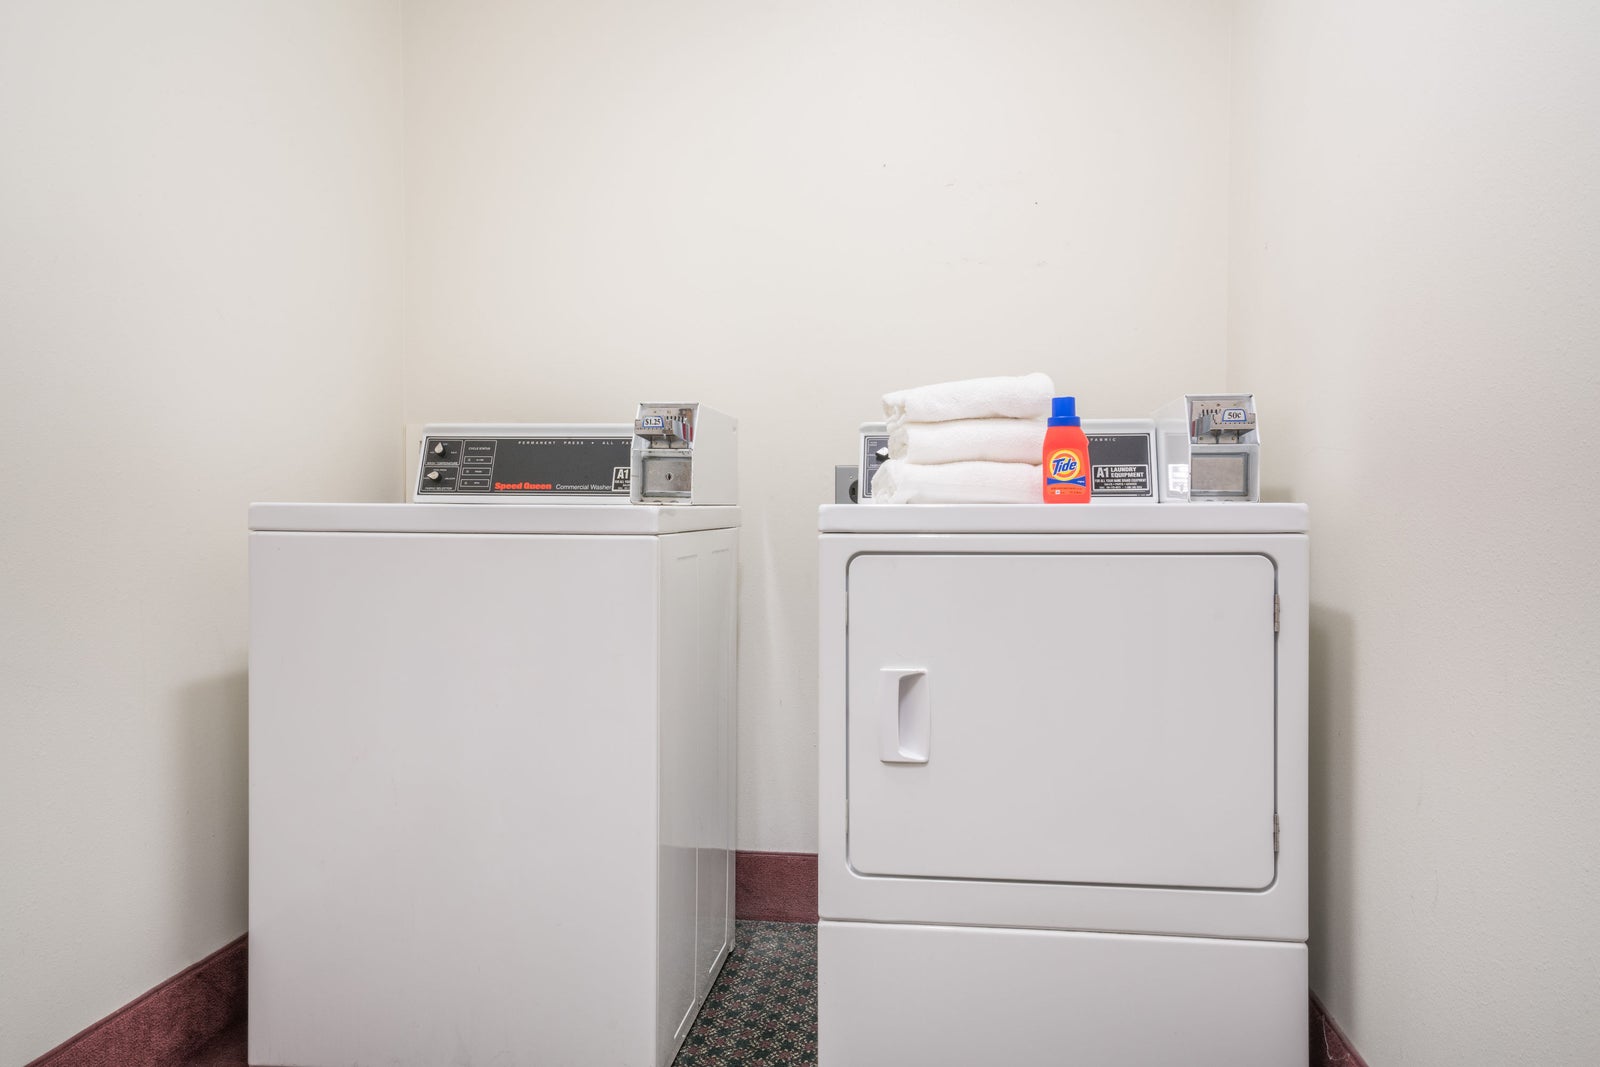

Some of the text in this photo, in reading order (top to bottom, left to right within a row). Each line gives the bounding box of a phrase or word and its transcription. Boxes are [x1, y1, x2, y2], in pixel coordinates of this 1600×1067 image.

[645, 418, 661, 426] $1.25
[1052, 458, 1077, 475] Tide
[616, 469, 629, 479] A1
[1096, 467, 1110, 478] A1
[494, 482, 523, 491] Speed
[523, 482, 552, 490] Queen
